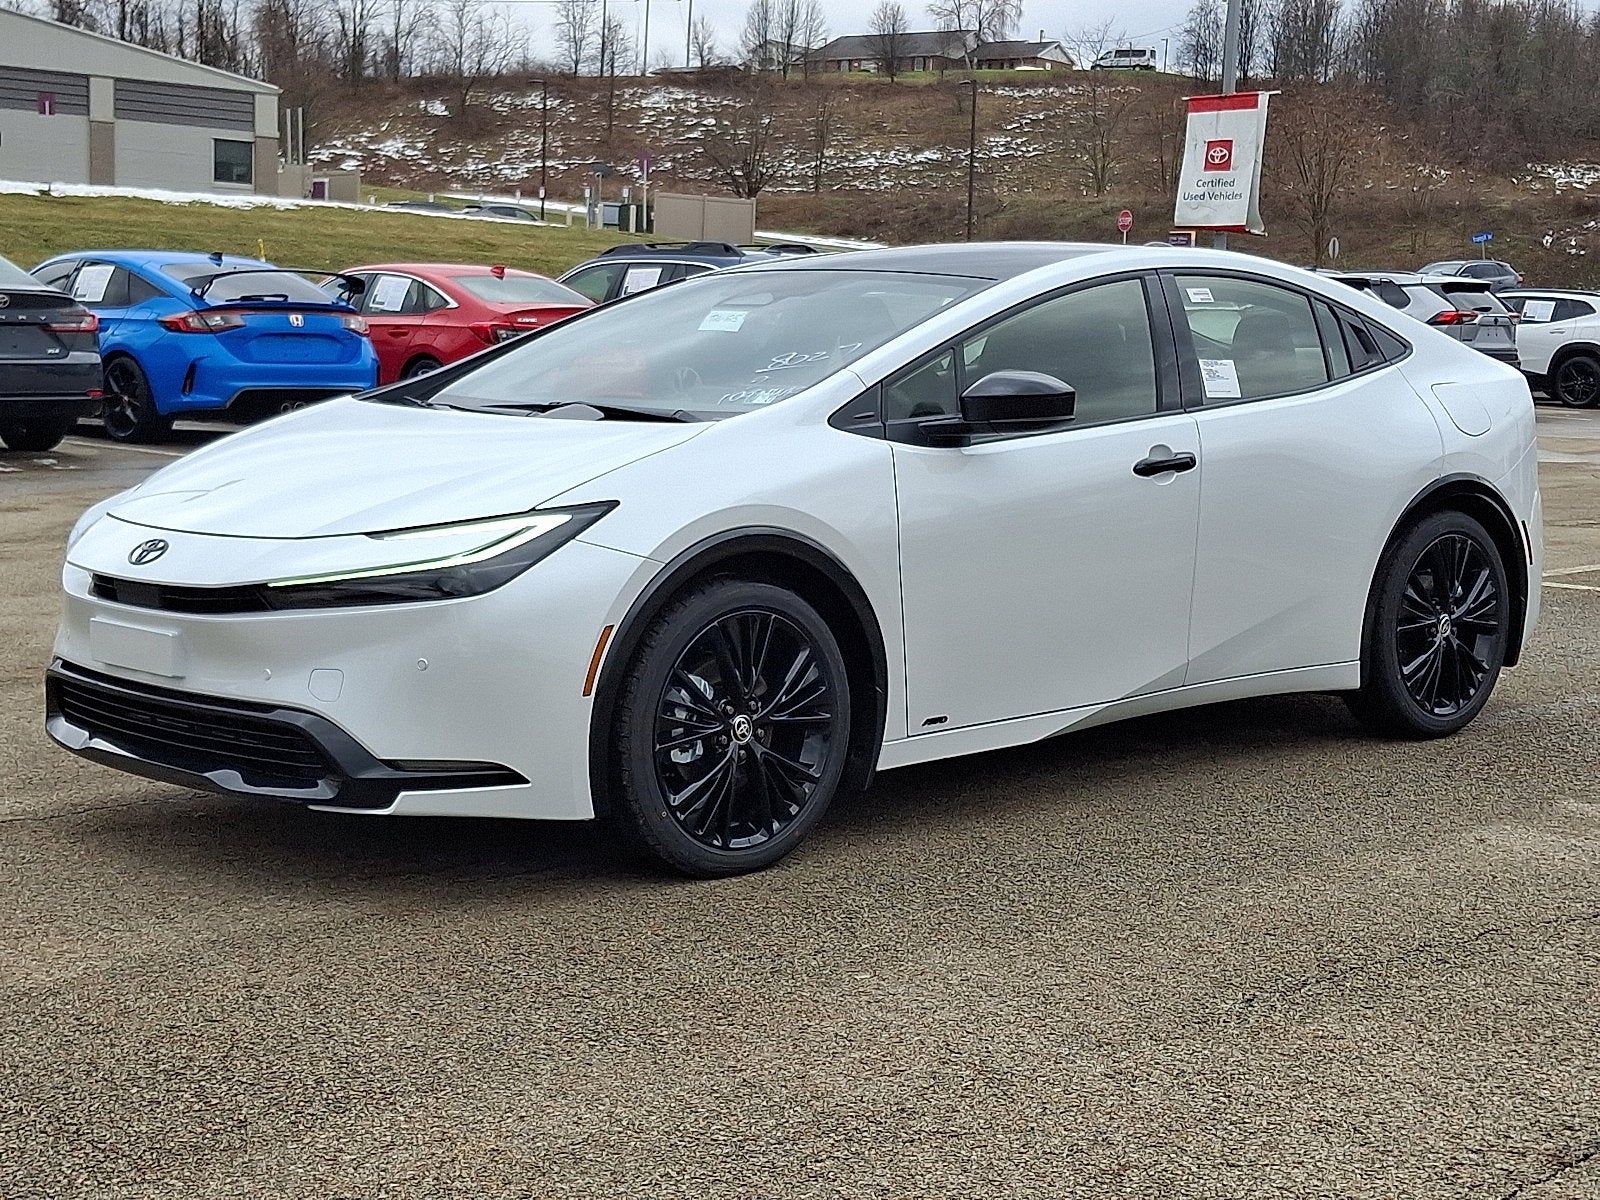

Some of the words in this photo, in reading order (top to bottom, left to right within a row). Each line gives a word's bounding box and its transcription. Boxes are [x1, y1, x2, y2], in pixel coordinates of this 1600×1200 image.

[1196, 178, 1236, 188] Certified
[1183, 191, 1206, 201] Used
[1207, 190, 1243, 200] Vehicles
